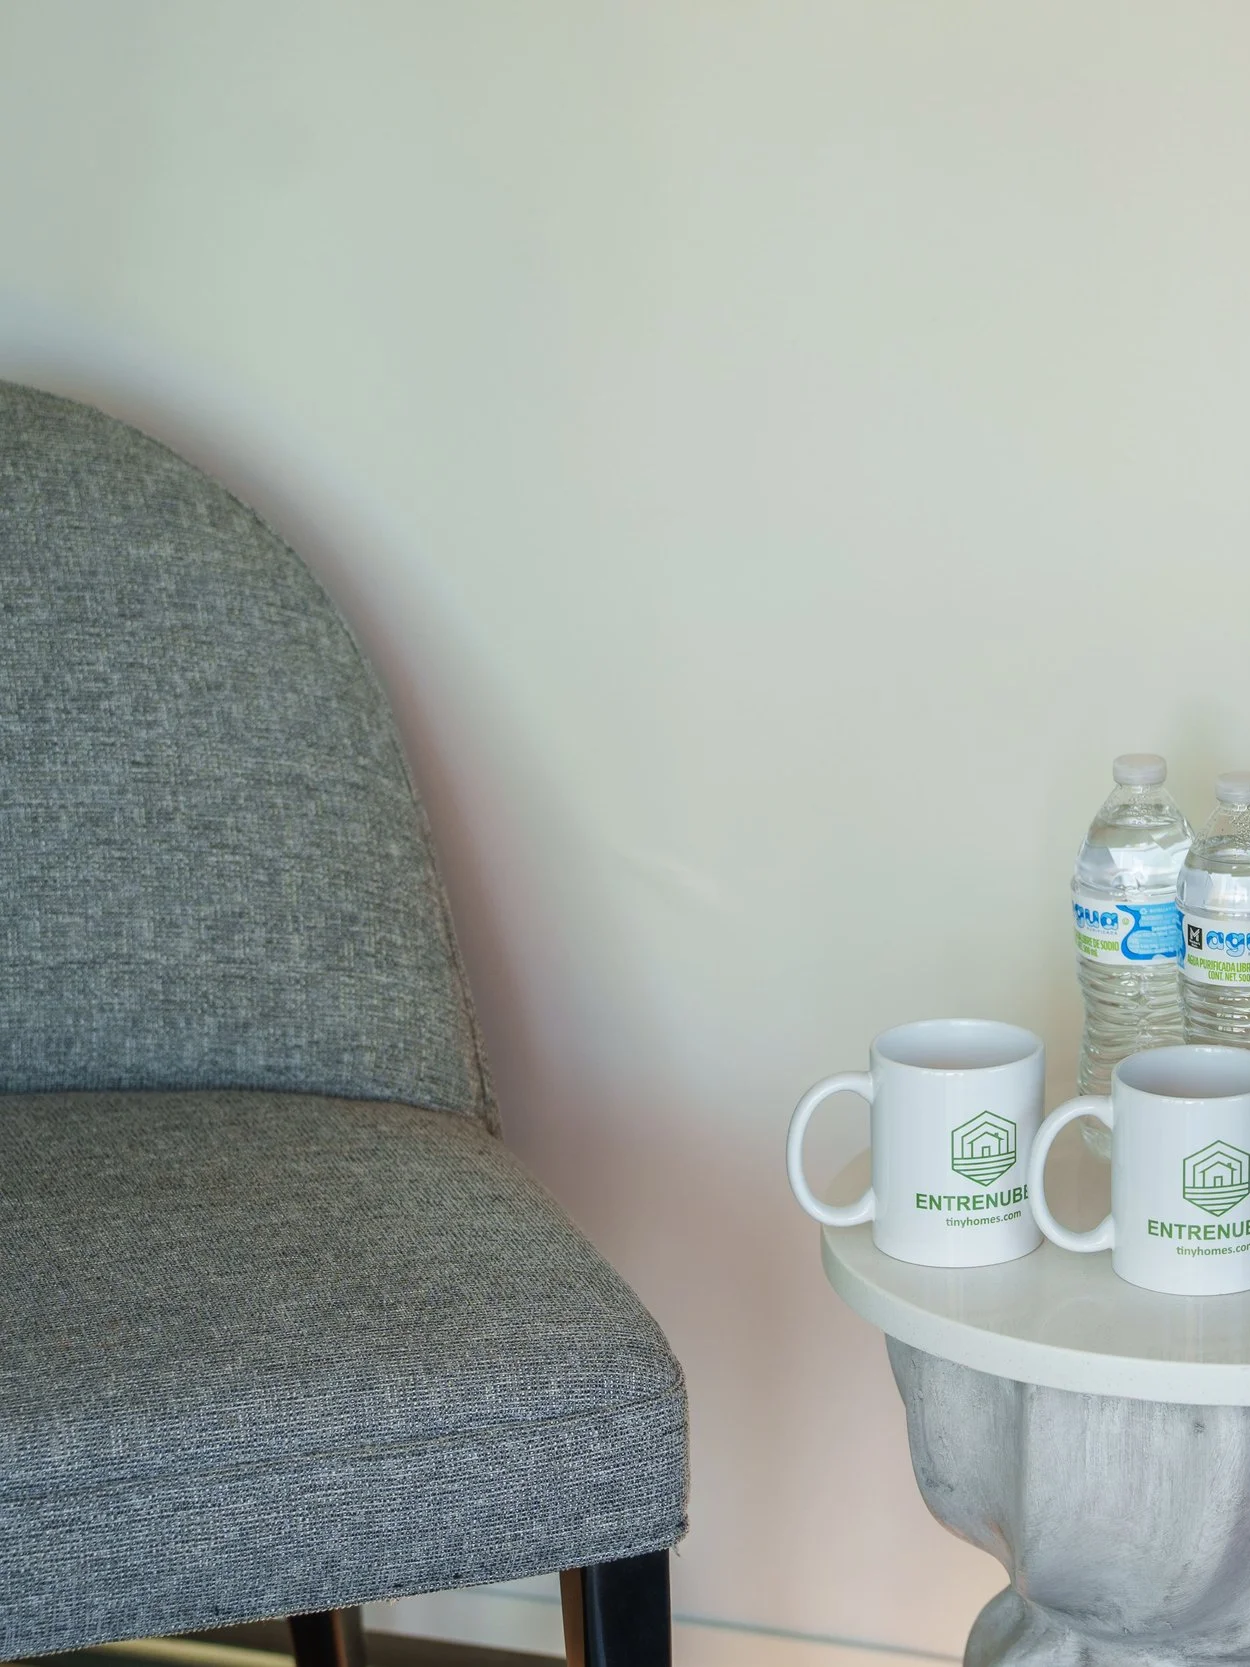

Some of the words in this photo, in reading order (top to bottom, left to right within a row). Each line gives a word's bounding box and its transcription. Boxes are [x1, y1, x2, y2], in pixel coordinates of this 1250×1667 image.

[1074, 903, 1119, 929] gua
[1199, 958, 1236, 972] PURIFICADA
[1238, 973, 1250, 982] 500
[915, 1184, 1029, 1211] ENTRENUBE
[946, 1210, 1022, 1228] tinyhomes.com
